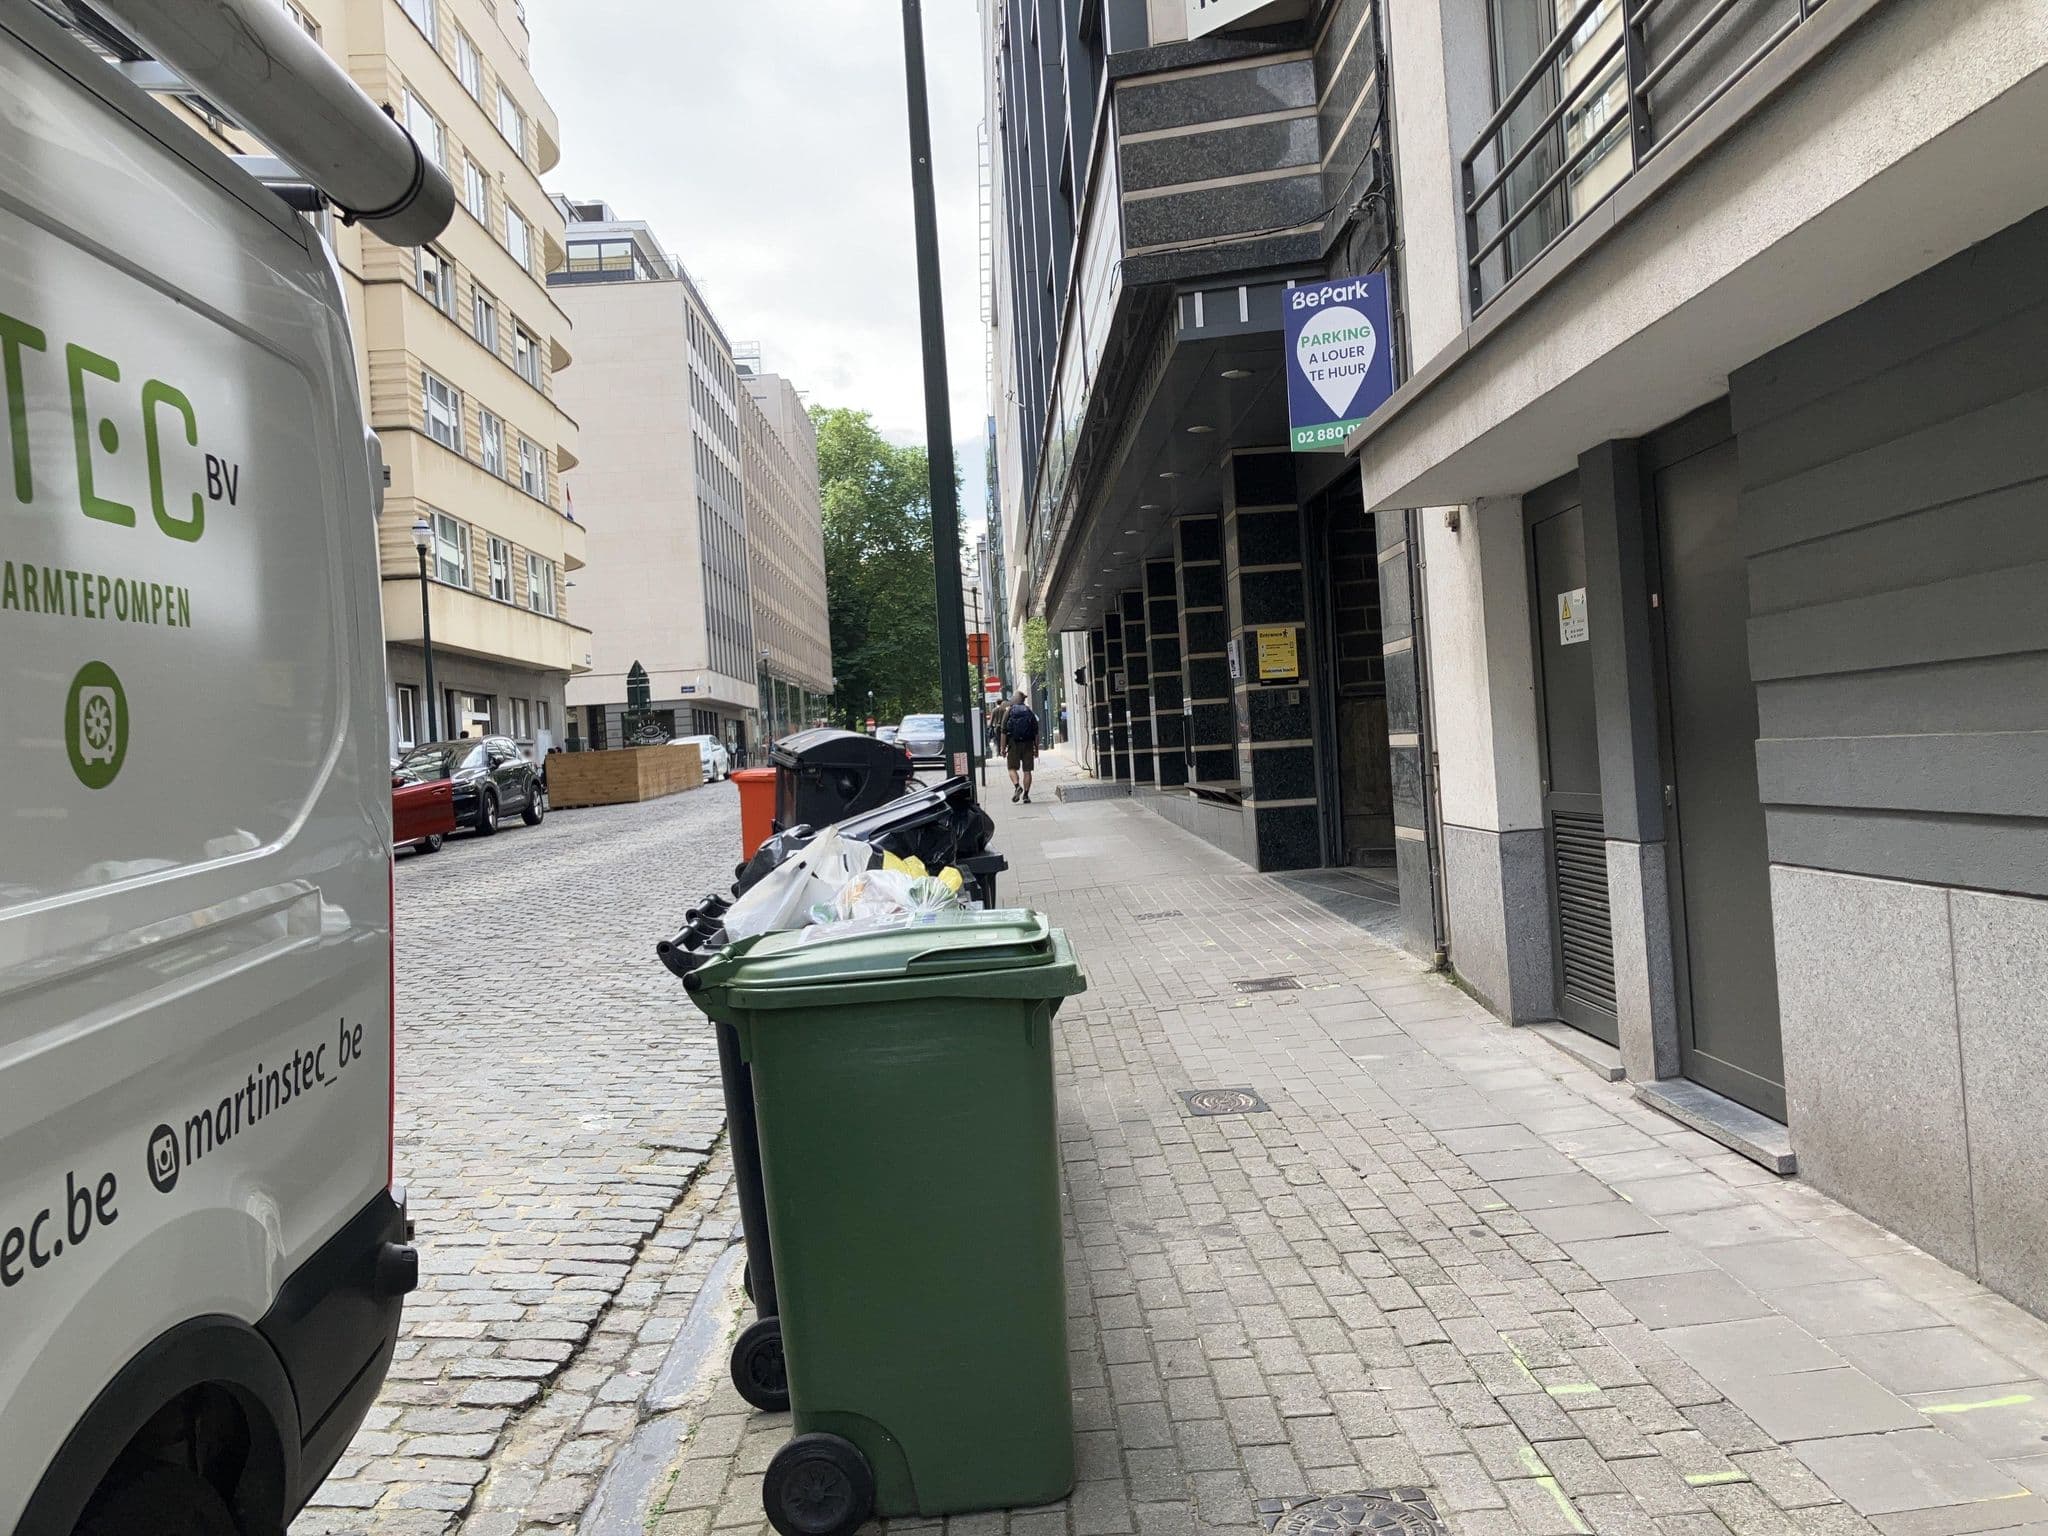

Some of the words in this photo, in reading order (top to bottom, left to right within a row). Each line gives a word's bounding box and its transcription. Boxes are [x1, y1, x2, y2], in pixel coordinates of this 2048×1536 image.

[1292, 281, 1369, 310] BePark
[1301, 325, 1371, 349] PARKING
[1309, 353, 1319, 365] A
[1322, 345, 1365, 362] LOUER
[1309, 369, 1325, 382] TE
[1328, 363, 1366, 379] HUUR
[1297, 431, 1315, 444] 02
[1317, 426, 1344, 441] 880
[204, 453, 239, 506] BV
[2, 560, 191, 629] ARMTEPOMPEN
